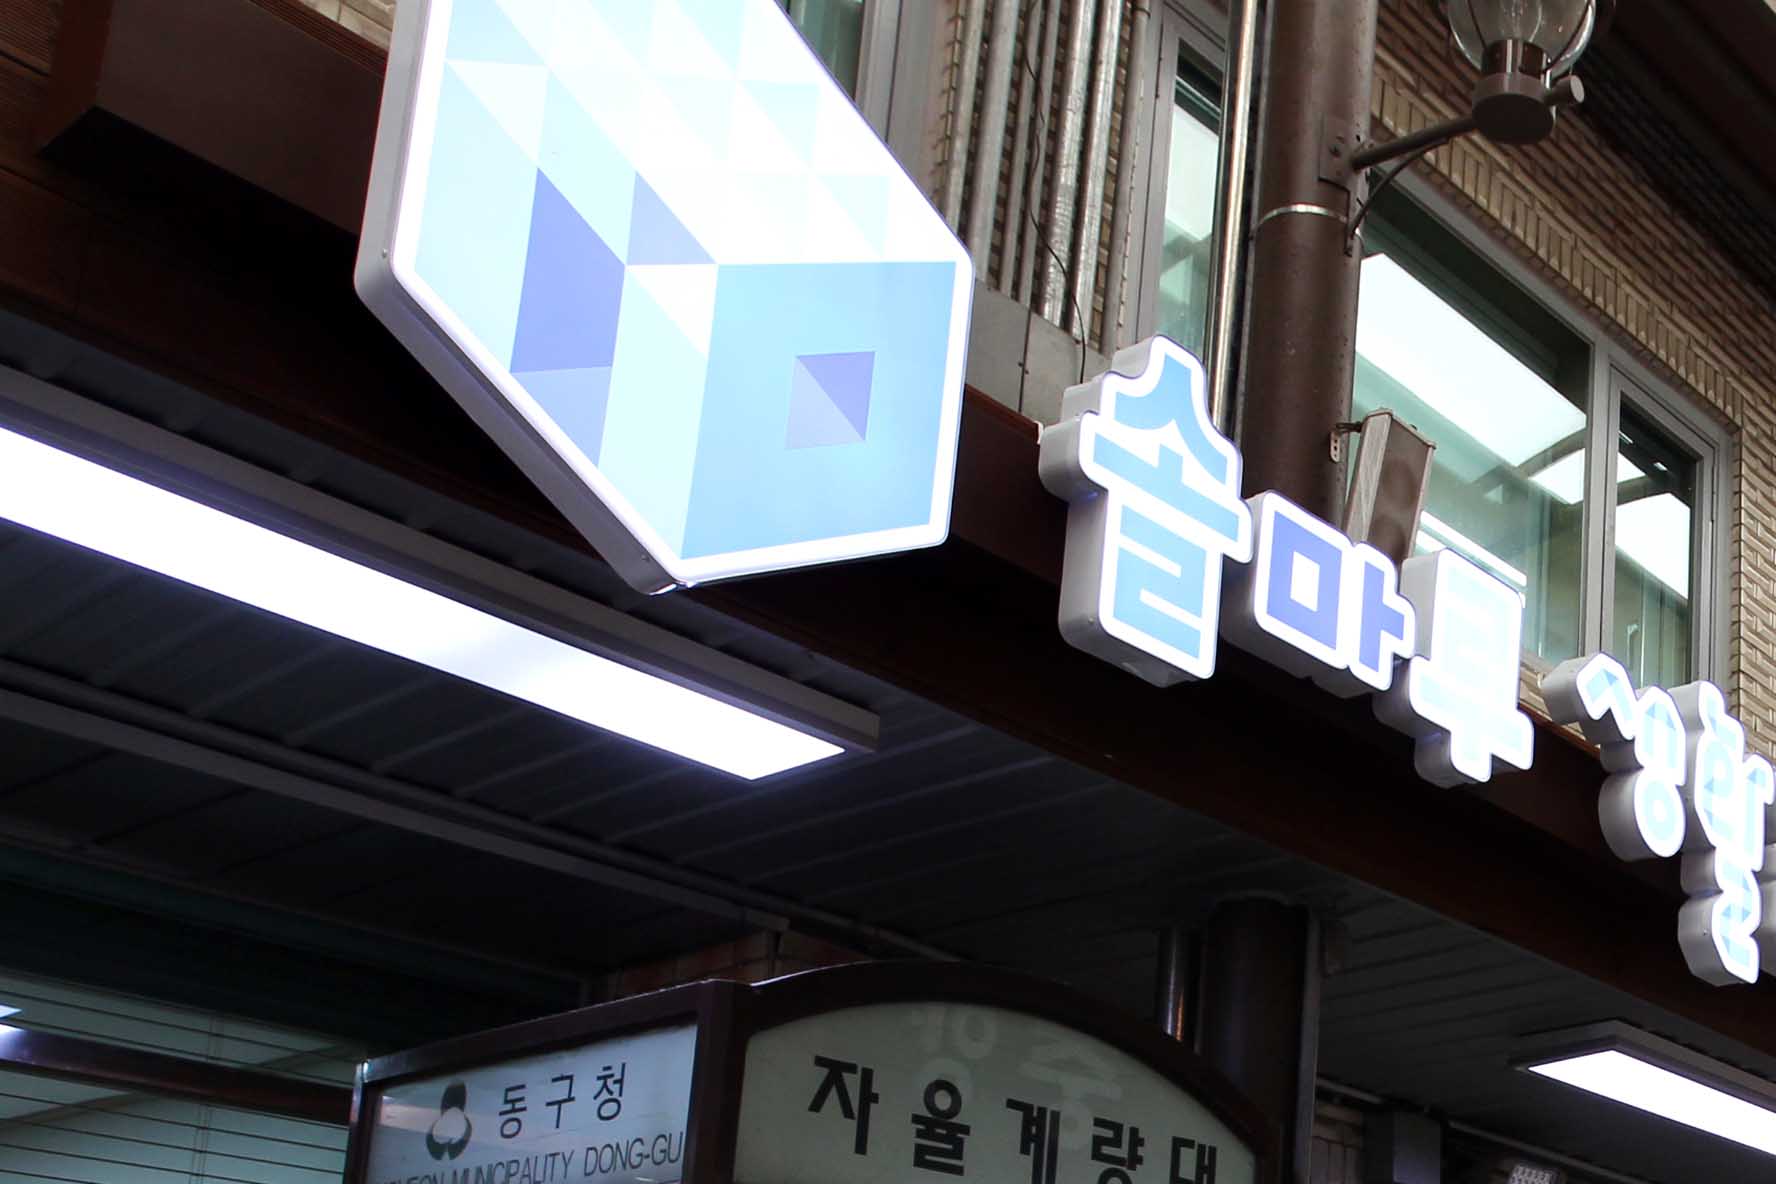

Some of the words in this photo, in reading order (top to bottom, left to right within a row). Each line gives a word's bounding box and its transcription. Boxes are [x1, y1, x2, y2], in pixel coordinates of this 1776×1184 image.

[1062, 335, 1533, 785] 솔마루
[498, 1061, 627, 1139] 동구청
[583, 1131, 684, 1178] DONG-GU
